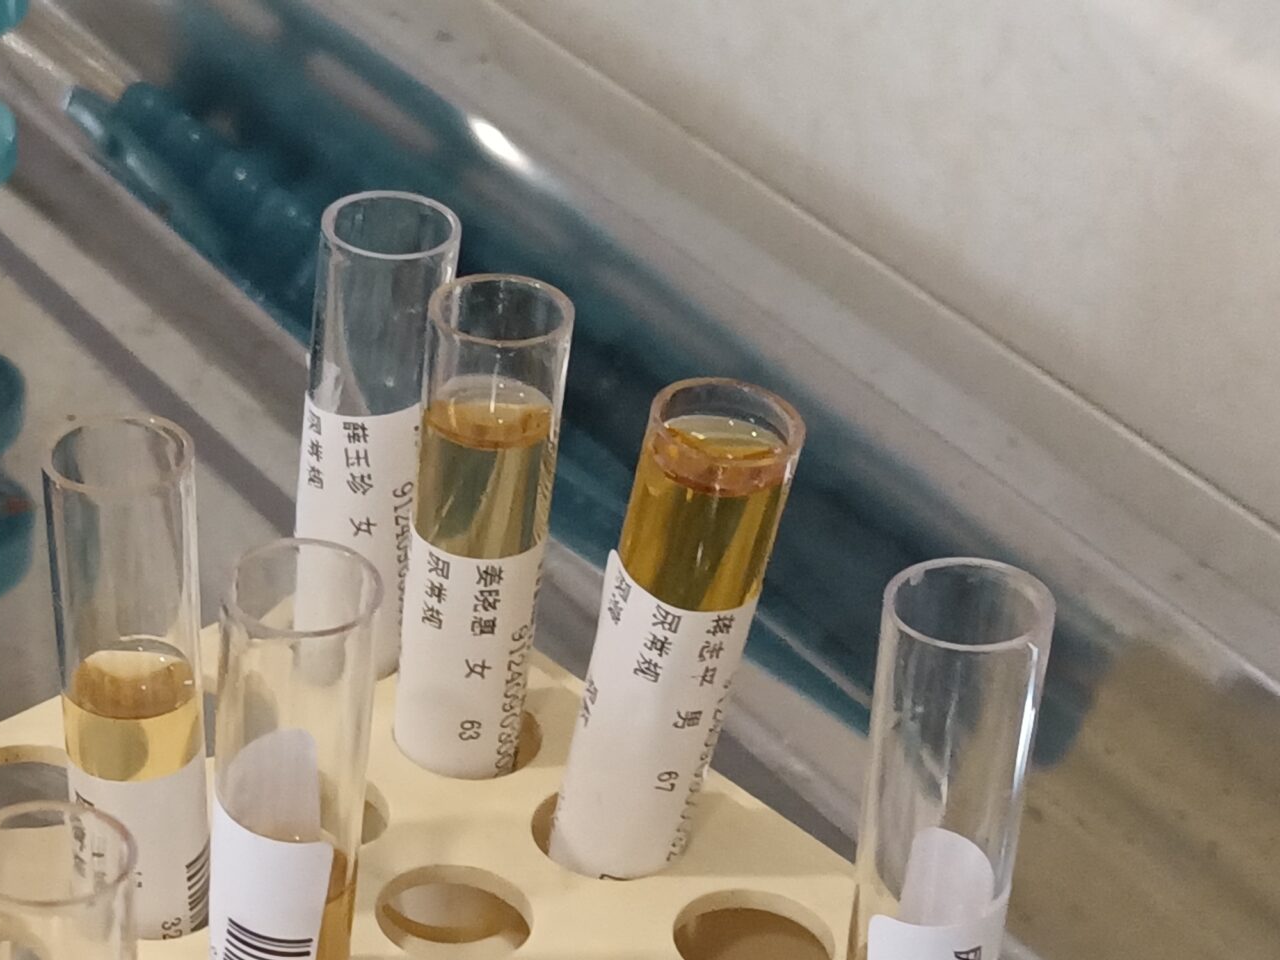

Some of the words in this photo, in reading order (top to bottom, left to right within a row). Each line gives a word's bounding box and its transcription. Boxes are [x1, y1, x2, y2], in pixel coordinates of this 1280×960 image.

[349, 516, 378, 537] 女
[421, 551, 451, 631] 尿常规
[471, 564, 505, 637] 姜晓惠
[633, 603, 685, 685] 尿常规
[465, 658, 493, 680] 女
[458, 719, 483, 742] 63
[671, 708, 704, 730] 男
[655, 770, 681, 793] 67
